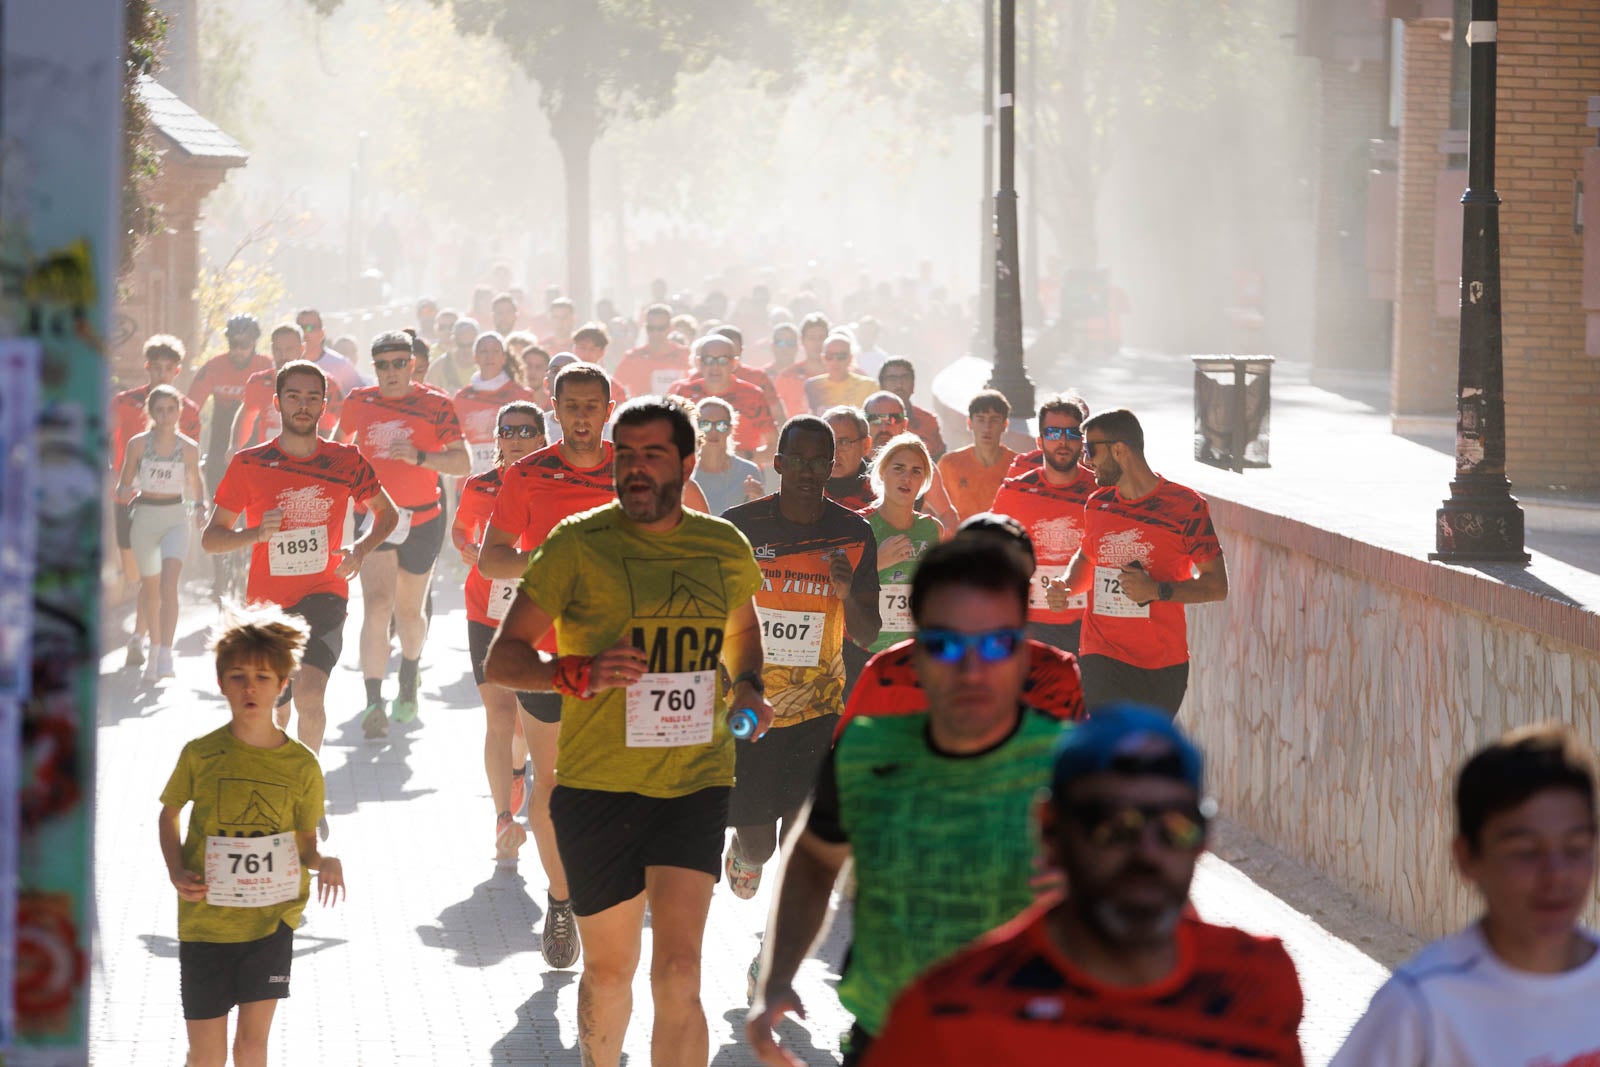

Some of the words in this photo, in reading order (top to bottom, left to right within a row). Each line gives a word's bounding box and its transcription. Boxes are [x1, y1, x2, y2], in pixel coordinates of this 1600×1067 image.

[277, 499, 329, 512] carrera
[277, 537, 318, 555] 1893
[1099, 542, 1148, 556] carrera
[1104, 578, 1125, 594] 72
[762, 620, 810, 640] 1607
[650, 688, 695, 711] 760
[227, 851, 273, 874] 761
